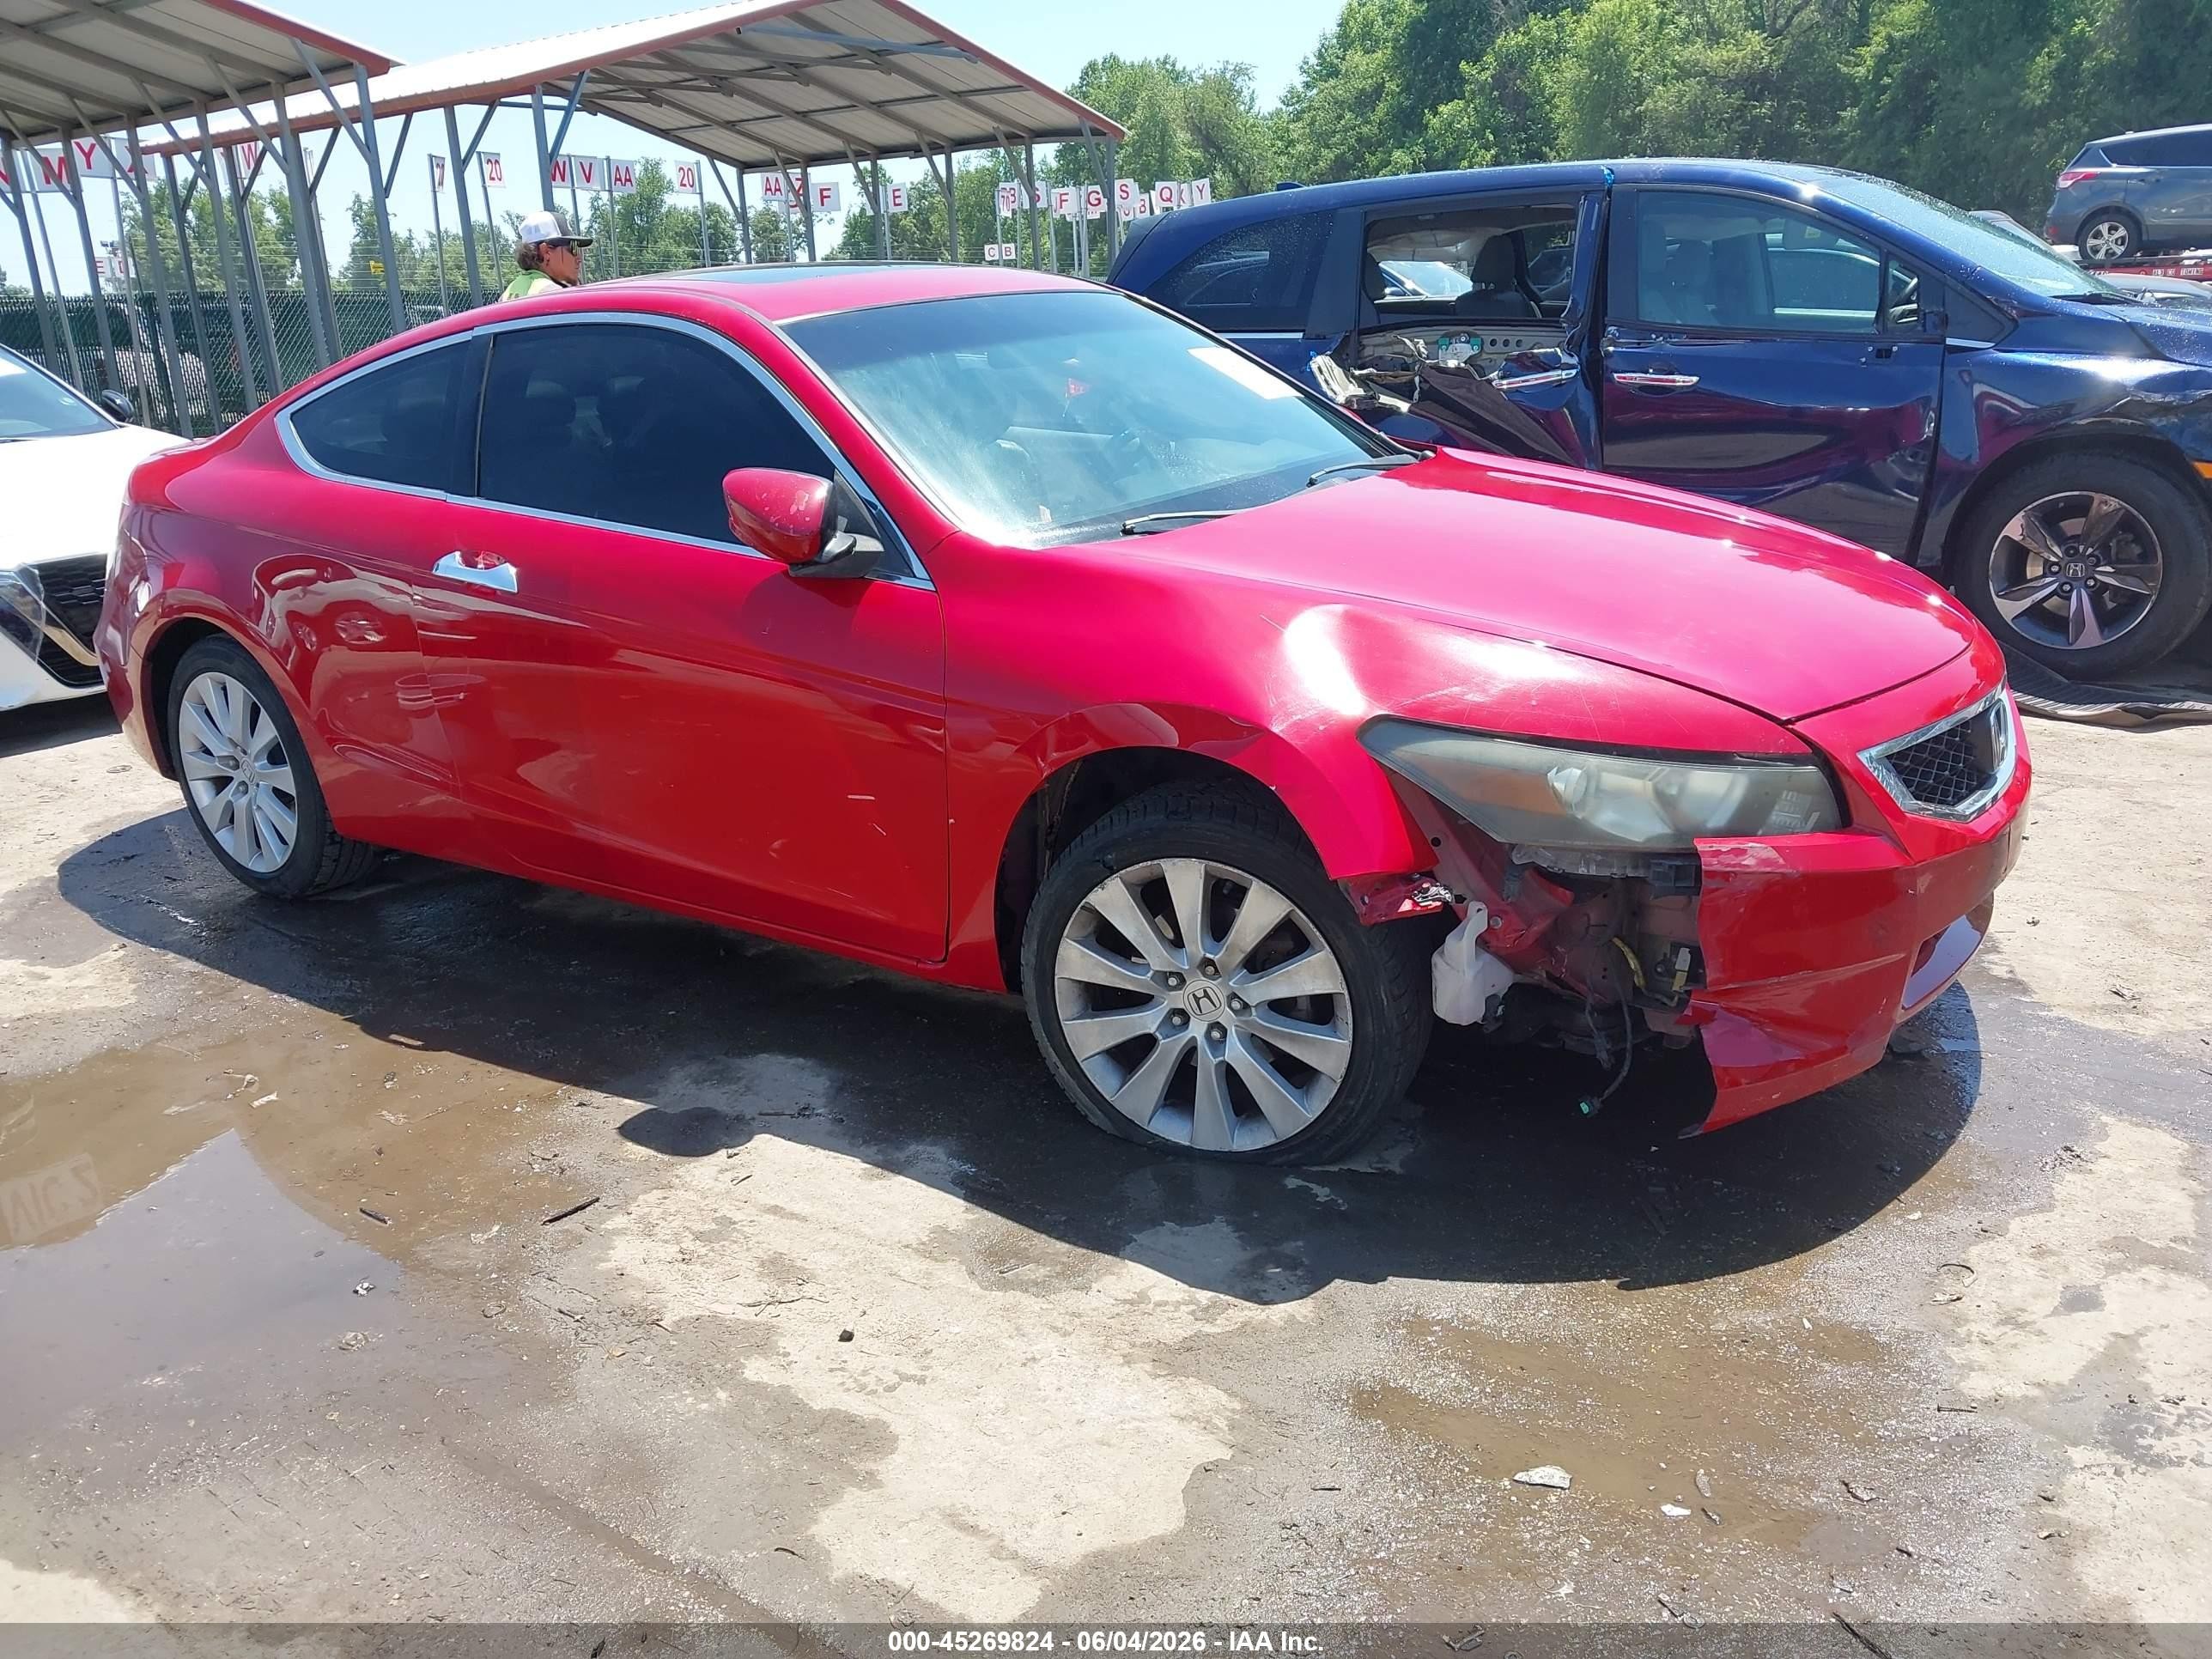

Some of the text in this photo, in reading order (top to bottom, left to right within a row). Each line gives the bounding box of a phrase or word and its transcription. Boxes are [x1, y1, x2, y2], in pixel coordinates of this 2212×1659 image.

[74, 141, 97, 170] Y
[486, 158, 502, 181] 20
[580, 161, 592, 184] V
[614, 165, 634, 186] AA
[678, 167, 695, 187] 20
[764, 177, 783, 196] AA
[1119, 183, 1130, 201] S
[1159, 186, 1174, 204] Q
[1195, 182, 1206, 200] Y
[819, 187, 832, 207] F
[892, 188, 903, 207] E
[1059, 191, 1070, 210] F
[1087, 190, 1103, 207] G
[988, 246, 997, 258] C
[1004, 246, 1012, 257] B
